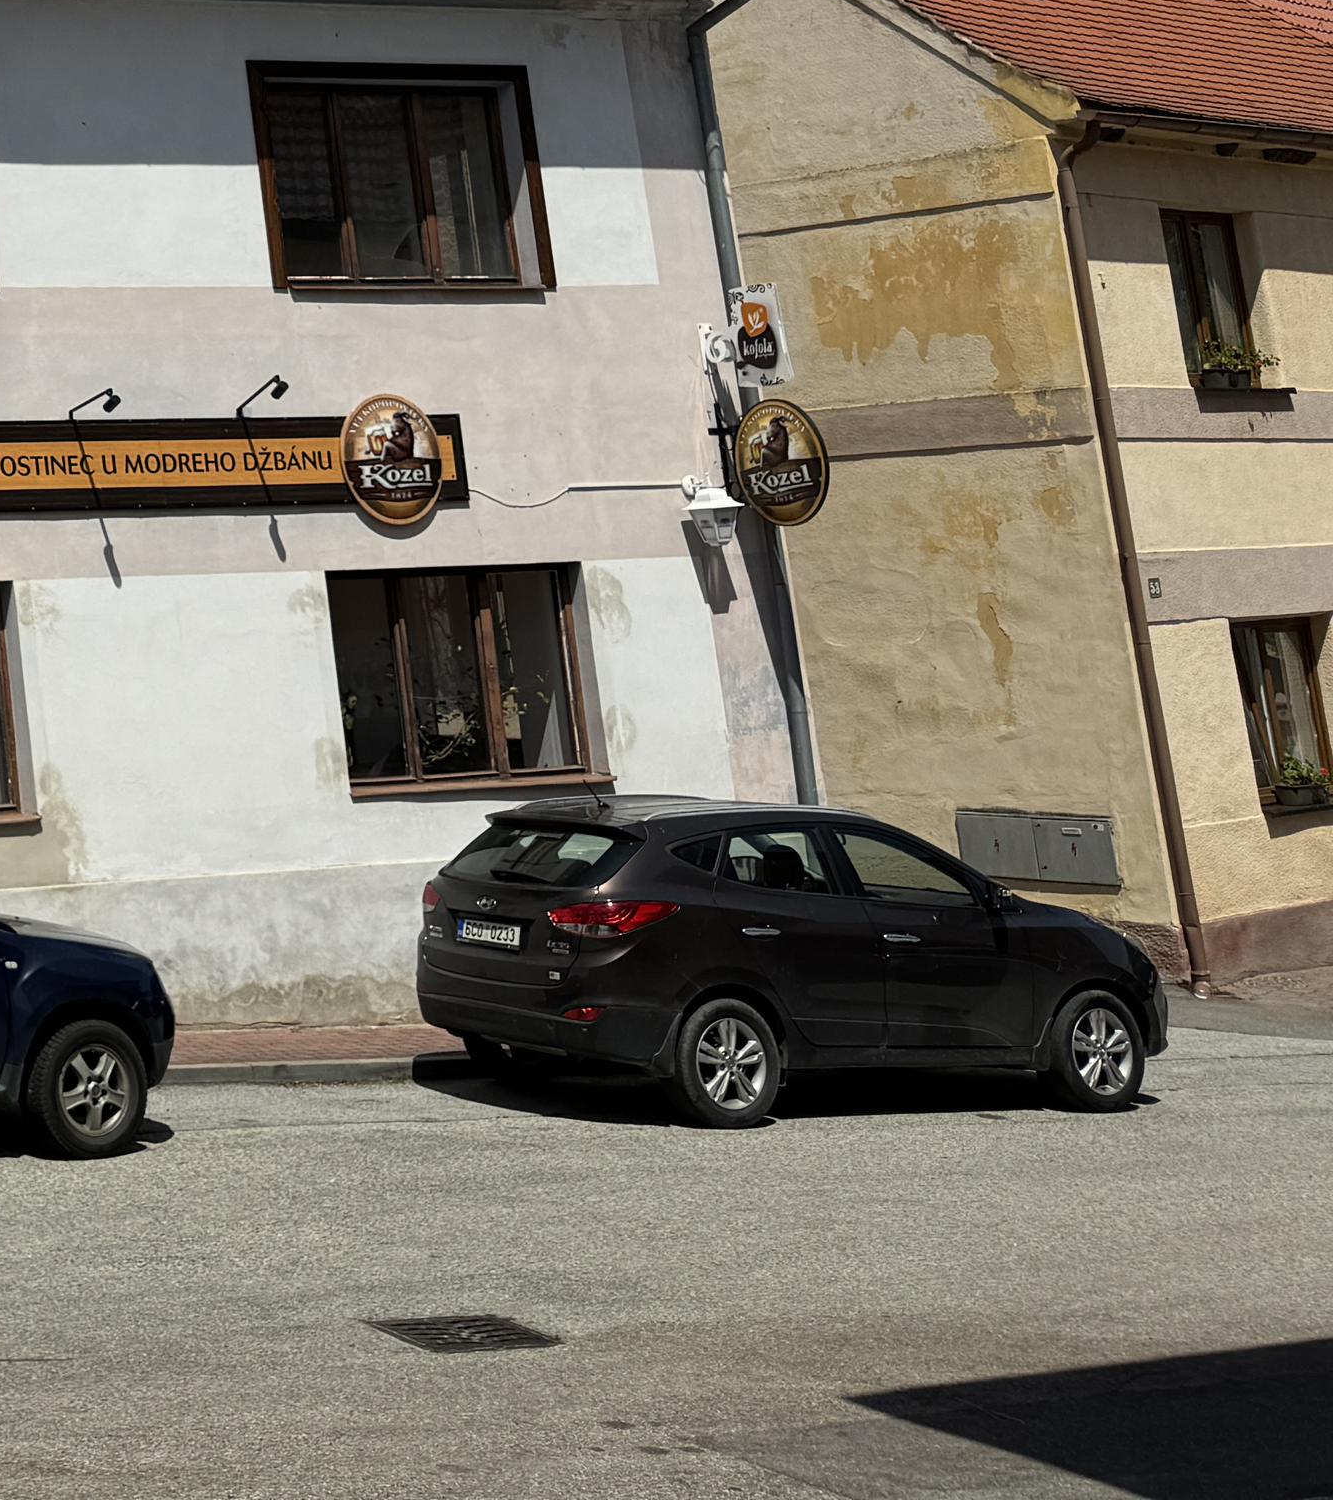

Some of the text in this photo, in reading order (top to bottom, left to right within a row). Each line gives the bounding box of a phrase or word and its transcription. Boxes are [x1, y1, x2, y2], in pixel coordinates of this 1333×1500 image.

[743, 338, 774, 359] kofola
[101, 454, 118, 475] U
[125, 452, 236, 475] MODREHO
[242, 445, 333, 472] DŽBÁNU
[358, 463, 433, 490] Kozel
[748, 464, 813, 497] Kozel
[464, 922, 516, 943] 6C0 0233
